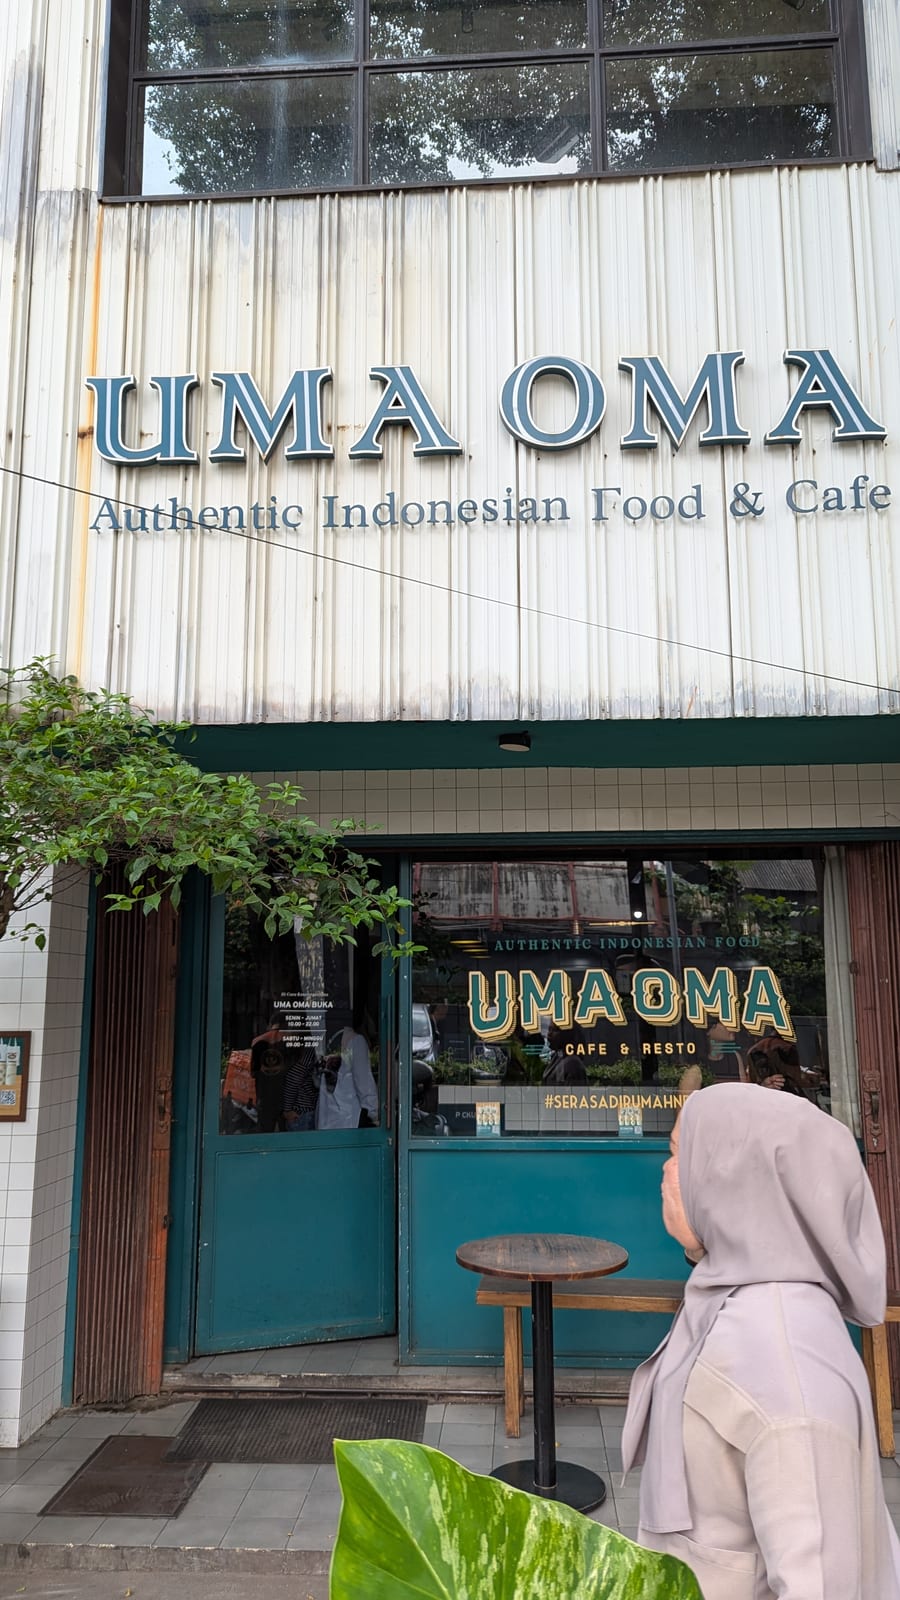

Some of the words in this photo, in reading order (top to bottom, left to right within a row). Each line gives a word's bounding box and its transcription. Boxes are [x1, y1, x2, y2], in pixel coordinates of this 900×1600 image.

[85, 364, 463, 467] UMA
[499, 347, 888, 452] OMA
[90, 495, 303, 532] Authentic
[322, 486, 571, 528] Indonesian
[591, 484, 703, 522] Food
[729, 482, 765, 518] &
[785, 475, 893, 513] Cafe
[494, 938, 593, 951] AUTHENTIC
[600, 936, 707, 950] INDONESIAN
[715, 935, 762, 949] FOOD
[565, 1043, 608, 1056] CAFE
[620, 1043, 630, 1055] &
[642, 1042, 697, 1055] RESTO
